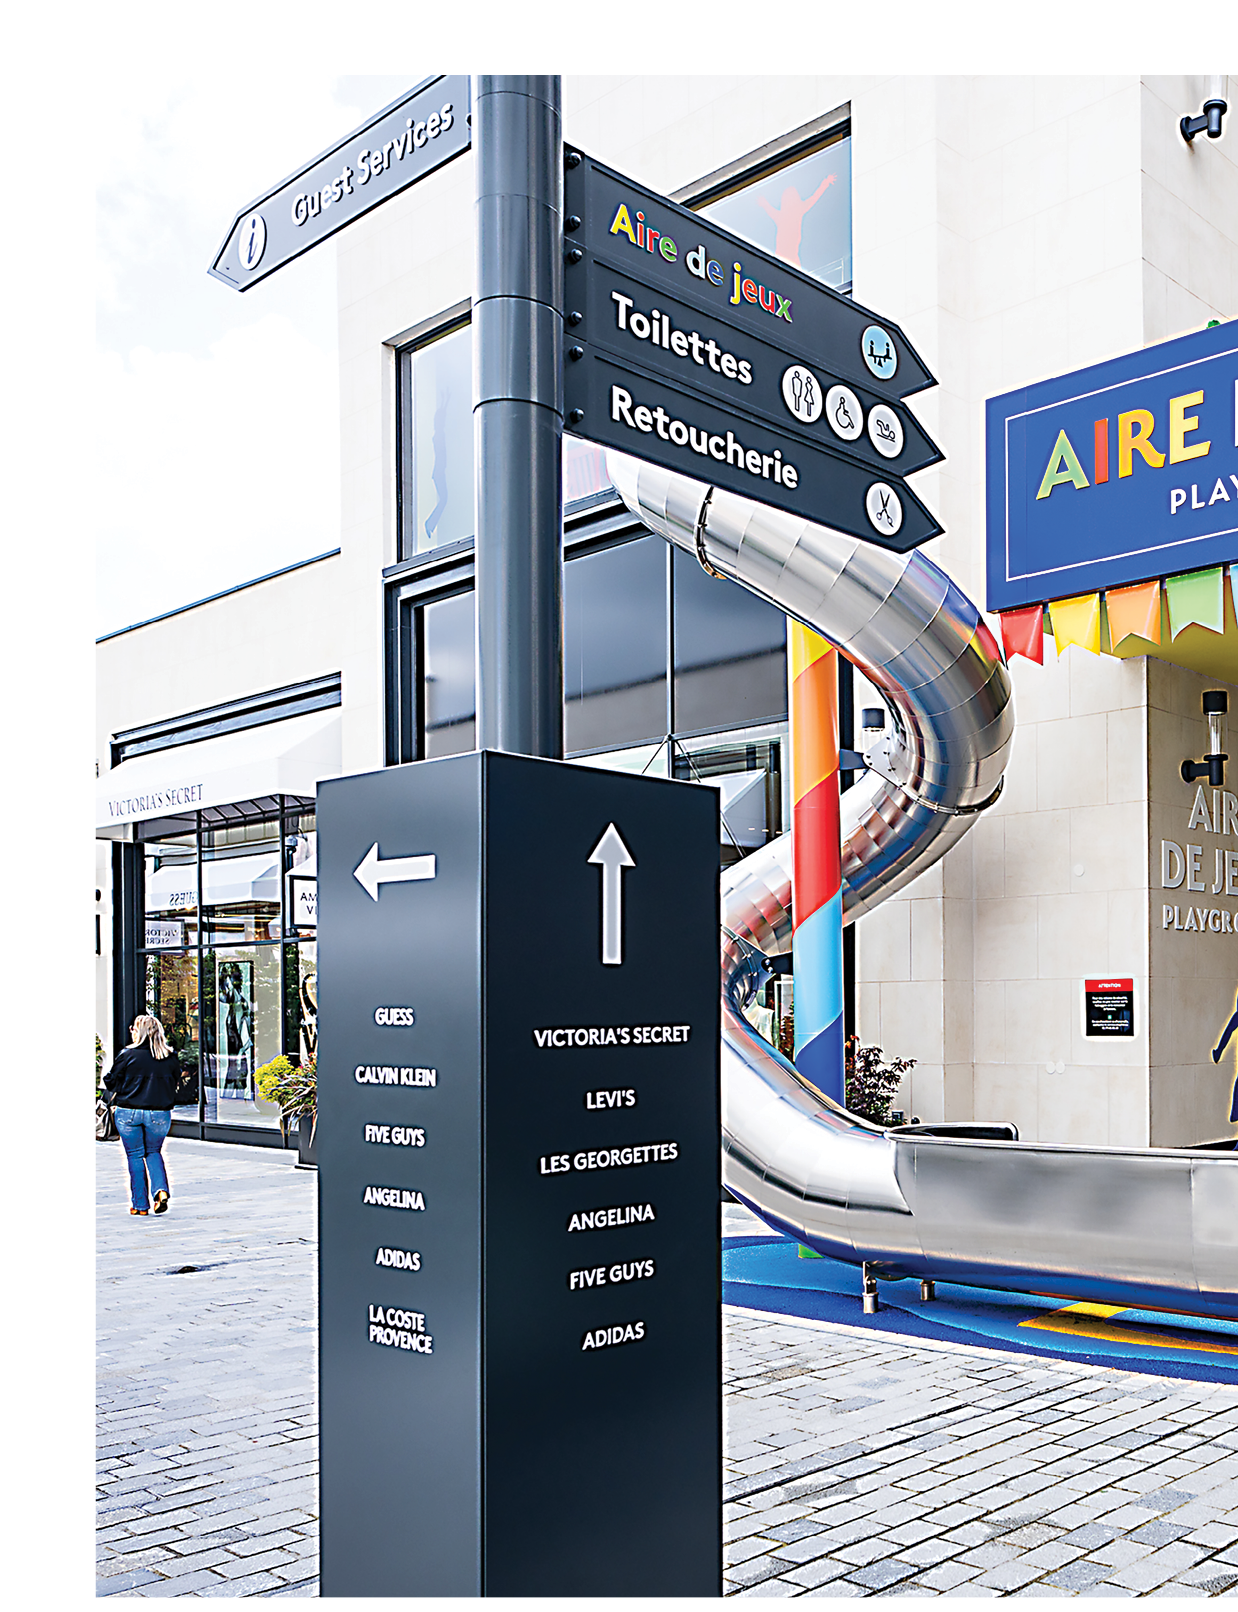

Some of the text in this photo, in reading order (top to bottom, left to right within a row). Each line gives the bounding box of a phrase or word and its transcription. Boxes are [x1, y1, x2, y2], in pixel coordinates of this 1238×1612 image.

[290, 101, 454, 227] Guest Services
[610, 203, 794, 323] Aire de jeux
[611, 291, 754, 386] Toilettes
[611, 385, 799, 490] Retoucherie
[1035, 389, 1211, 501] AIRE
[108, 783, 204, 817] VICTORIA'S SECRET
[1161, 839, 1205, 893] DE
[374, 1007, 414, 1026] GUESS
[534, 1026, 691, 1047] VICTORIA'S SECRET
[354, 1066, 437, 1087] CALVIN KLEIN
[586, 1089, 636, 1109] LEVI'S
[365, 1124, 425, 1147] FIVE GUYS
[540, 1143, 678, 1174] LES GEORGETTES
[363, 1187, 425, 1210] ANGELINA
[568, 1204, 655, 1232] ANGELINA
[375, 1249, 421, 1271] ADIDAS
[569, 1260, 655, 1290] FIVE GUYS
[369, 1304, 425, 1332] LA COSTE
[369, 1326, 433, 1354] PROVENCE
[582, 1321, 645, 1351] ADIDAS
